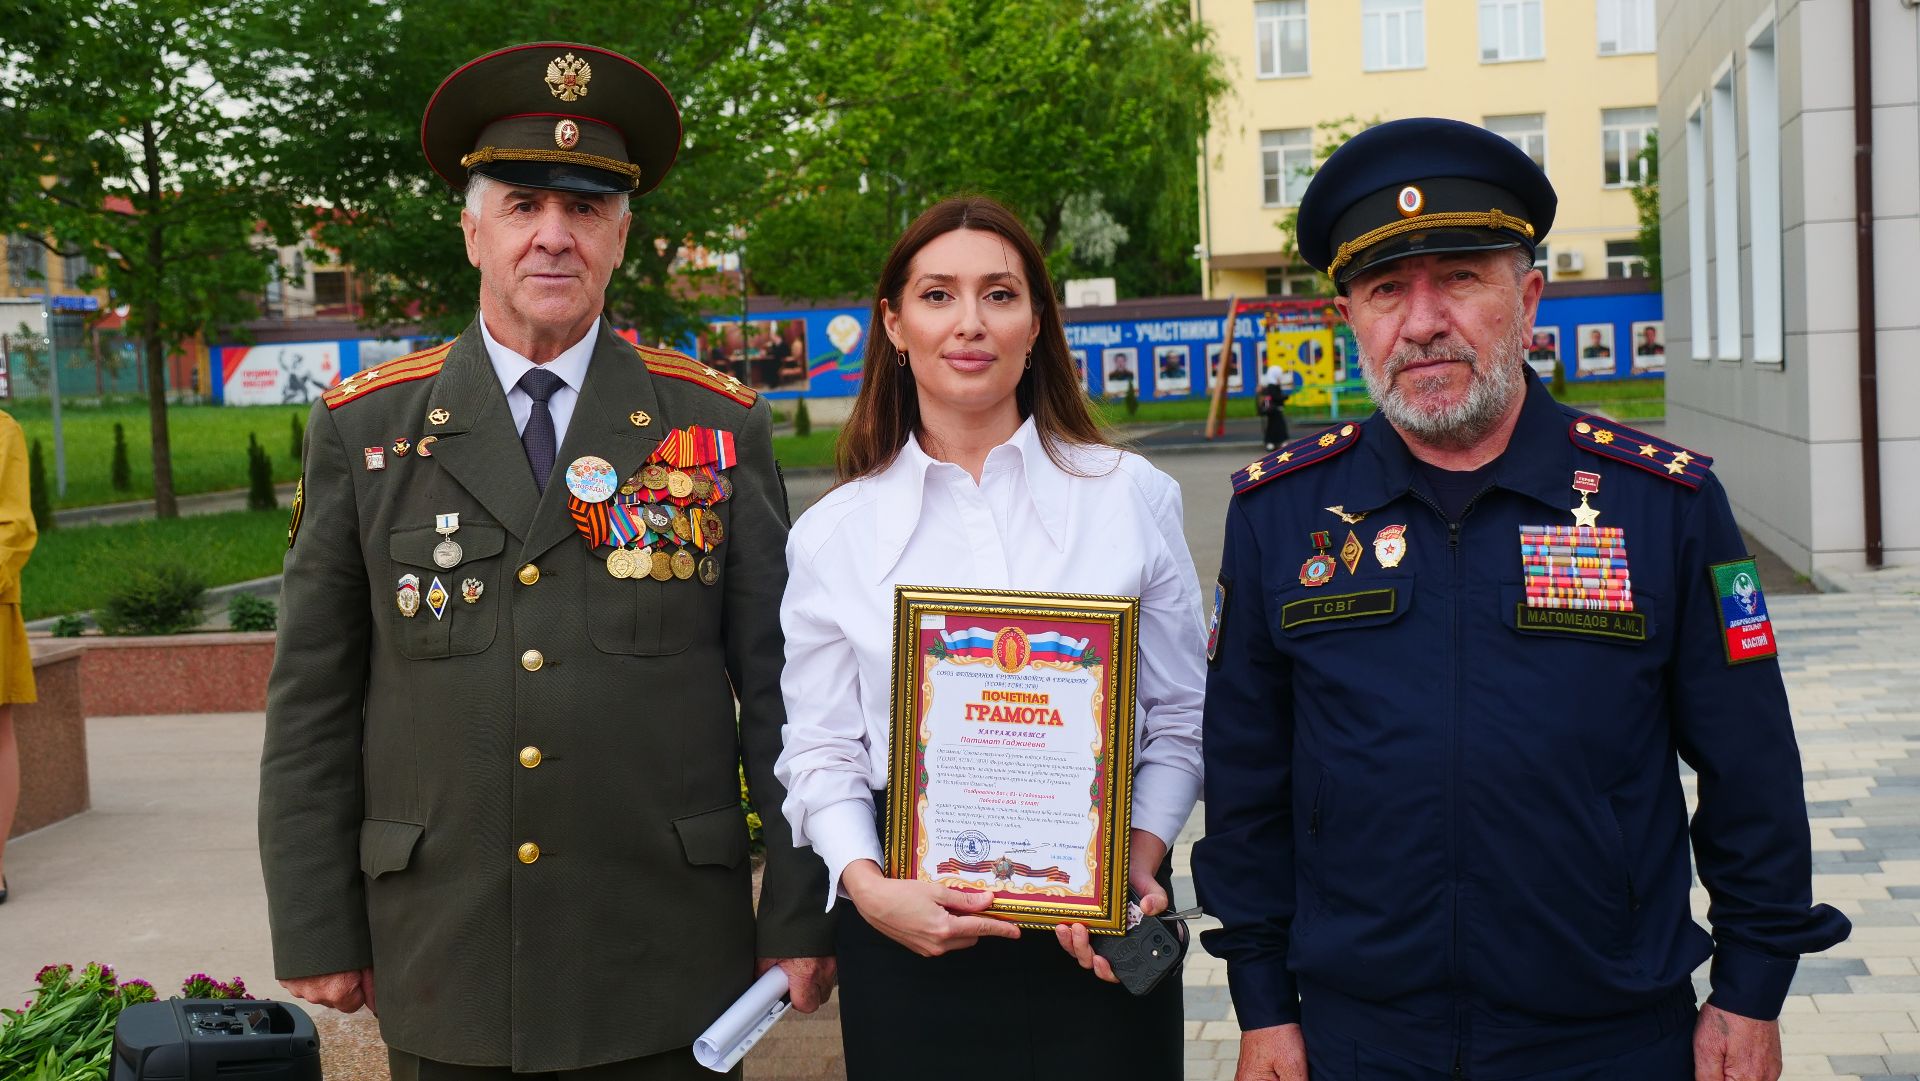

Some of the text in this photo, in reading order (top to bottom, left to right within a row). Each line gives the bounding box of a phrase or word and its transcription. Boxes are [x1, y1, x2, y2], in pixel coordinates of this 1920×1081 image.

[1065, 324, 1121, 347] СТАНЦЫ
[1135, 322, 1218, 344] УЧАСТНИКИ
[1313, 600, 1356, 615] ГСВГ
[1527, 610, 1639, 632] МАГОМЕДОВ А.М.
[1741, 632, 1768, 650] КАСПИЙ
[982, 690, 1049, 705] ПОЧЕТНАЯ
[965, 704, 1064, 726] ГРАМОТА
[960, 736, 1046, 748] Патимат Гаджиевна
